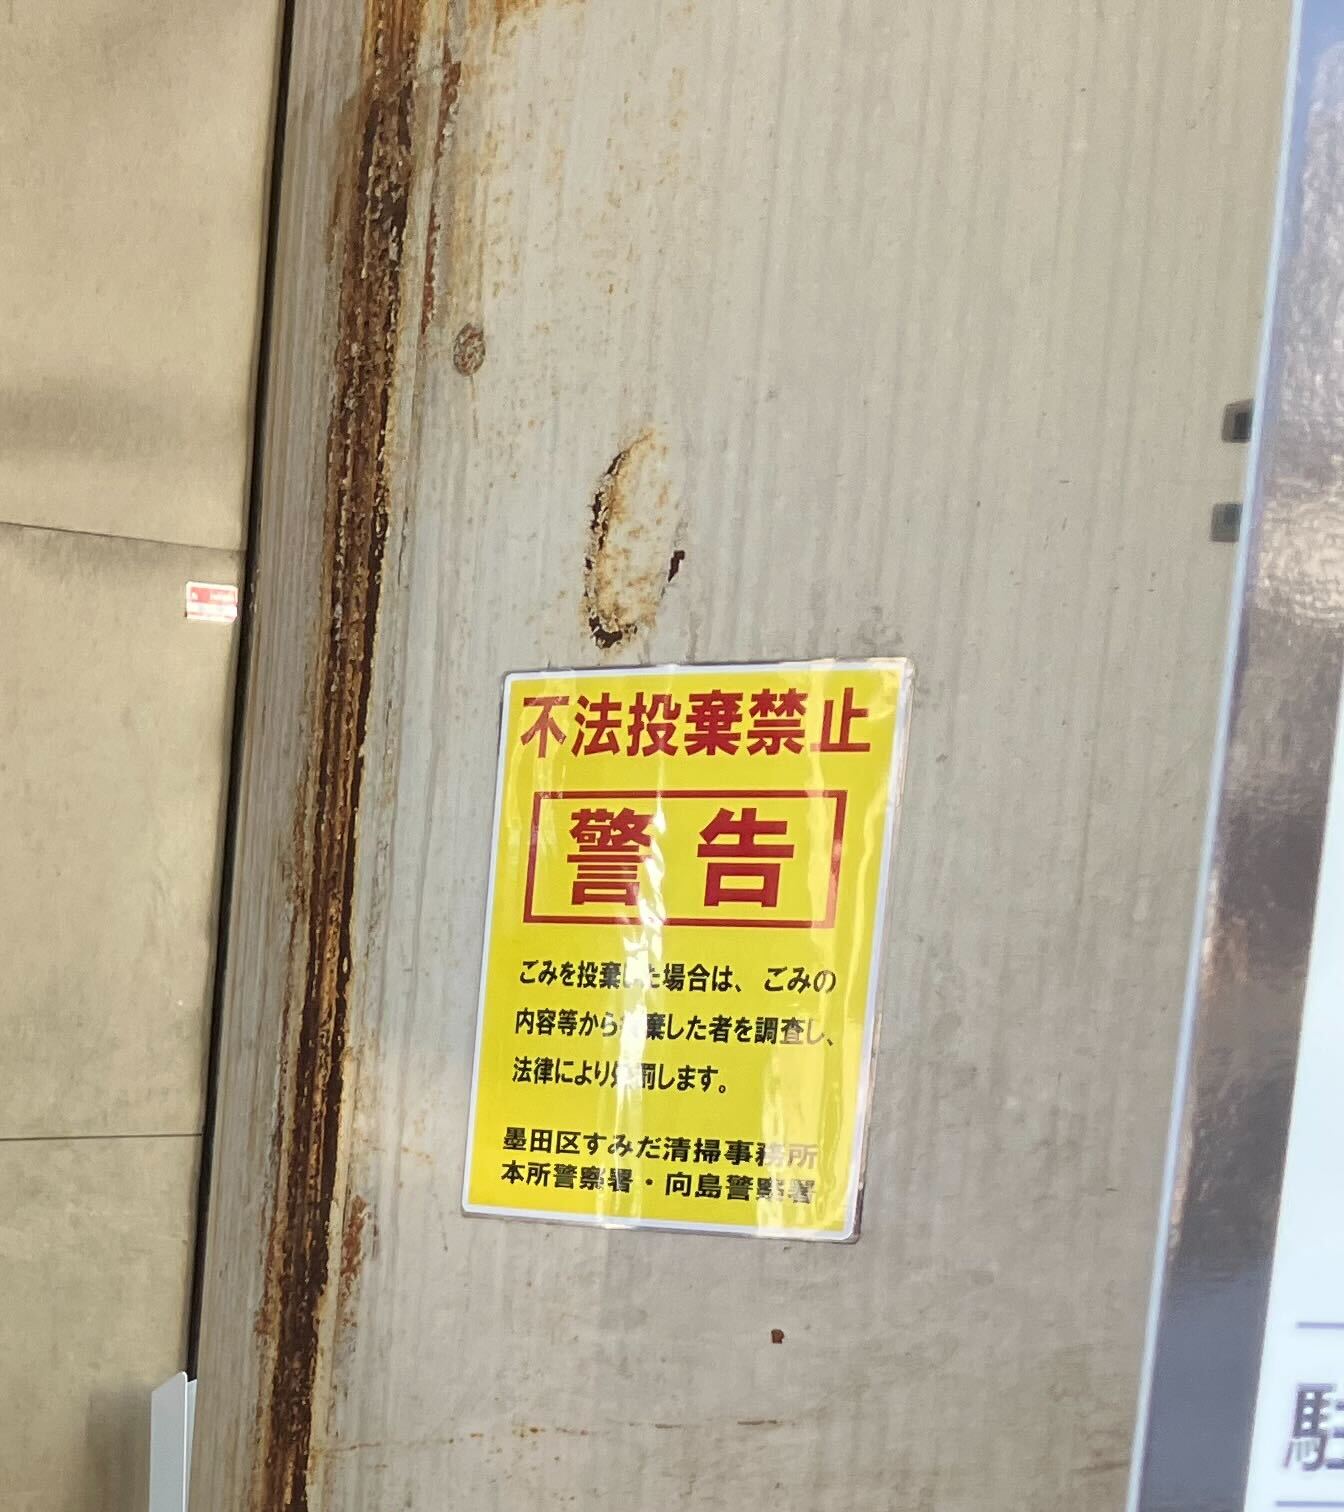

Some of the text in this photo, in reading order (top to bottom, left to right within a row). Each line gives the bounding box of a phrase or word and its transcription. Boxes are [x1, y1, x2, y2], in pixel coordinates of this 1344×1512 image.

[519, 687, 872, 759] 不法投棄禁止
[567, 807, 795, 908] 警告
[514, 1007, 835, 1047] 内容等から棄した者を調査し、
